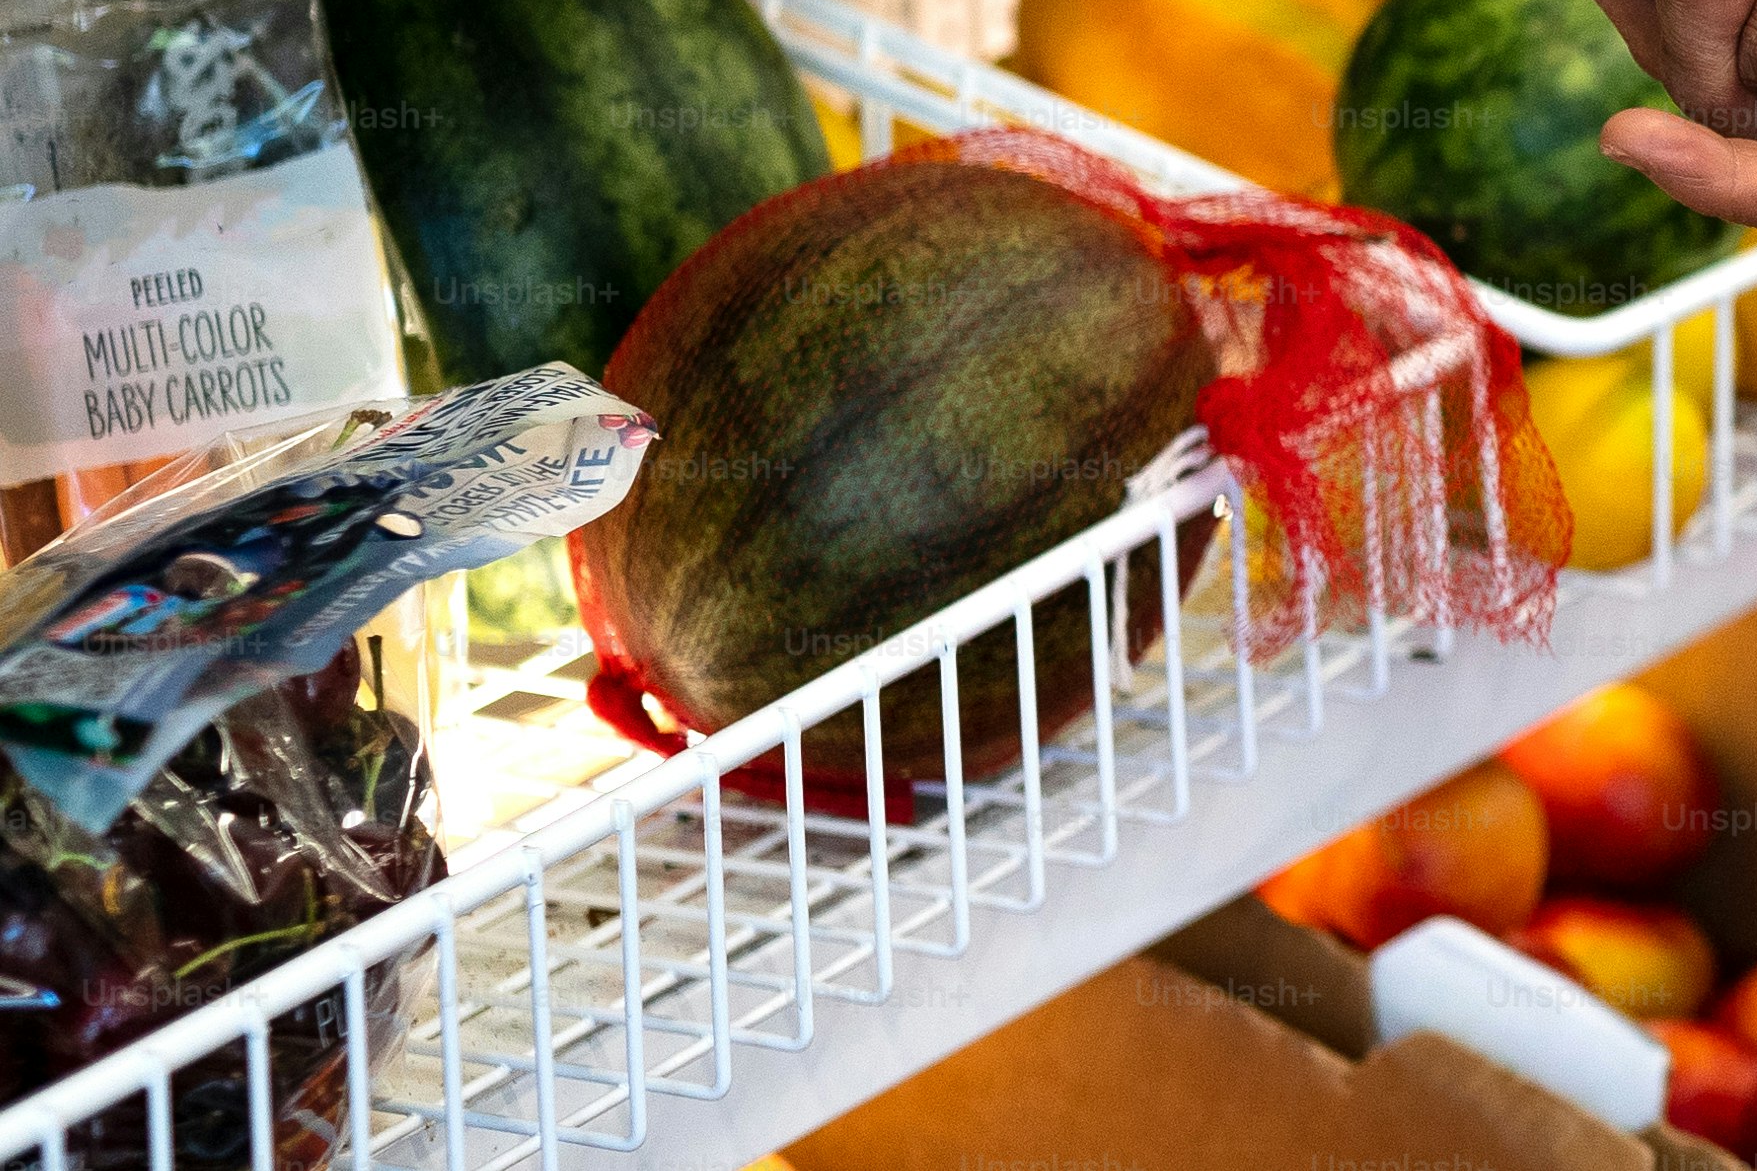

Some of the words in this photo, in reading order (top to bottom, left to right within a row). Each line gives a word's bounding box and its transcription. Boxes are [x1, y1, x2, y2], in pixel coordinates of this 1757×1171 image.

[130, 267, 204, 310] PEELED
[82, 301, 273, 381] MULTI-COLOR
[83, 381, 156, 440] BABY
[166, 355, 292, 426] CARROTS
